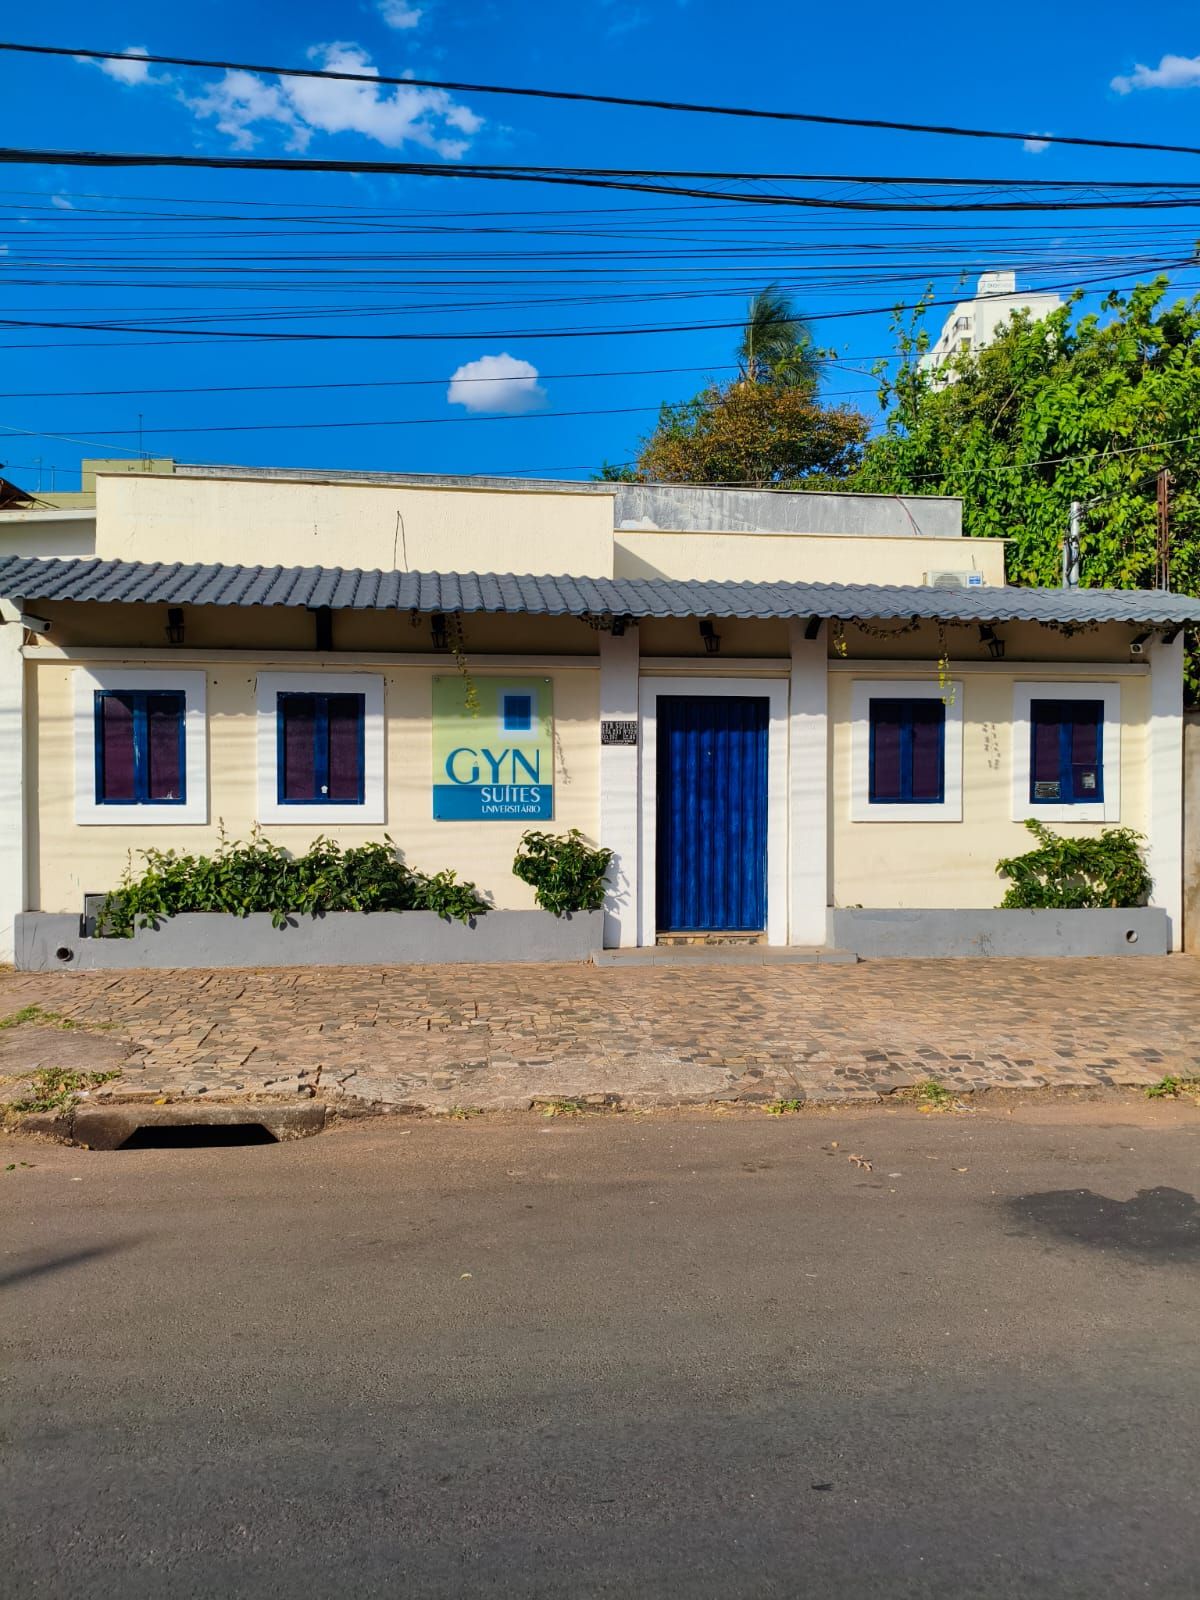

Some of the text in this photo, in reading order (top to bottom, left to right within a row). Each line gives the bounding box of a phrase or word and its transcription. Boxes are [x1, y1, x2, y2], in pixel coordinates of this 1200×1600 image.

[445, 747, 540, 785] GYN
[481, 785, 540, 803] SUÍTES
[481, 803, 541, 814] UNIVERSITÁRIO
